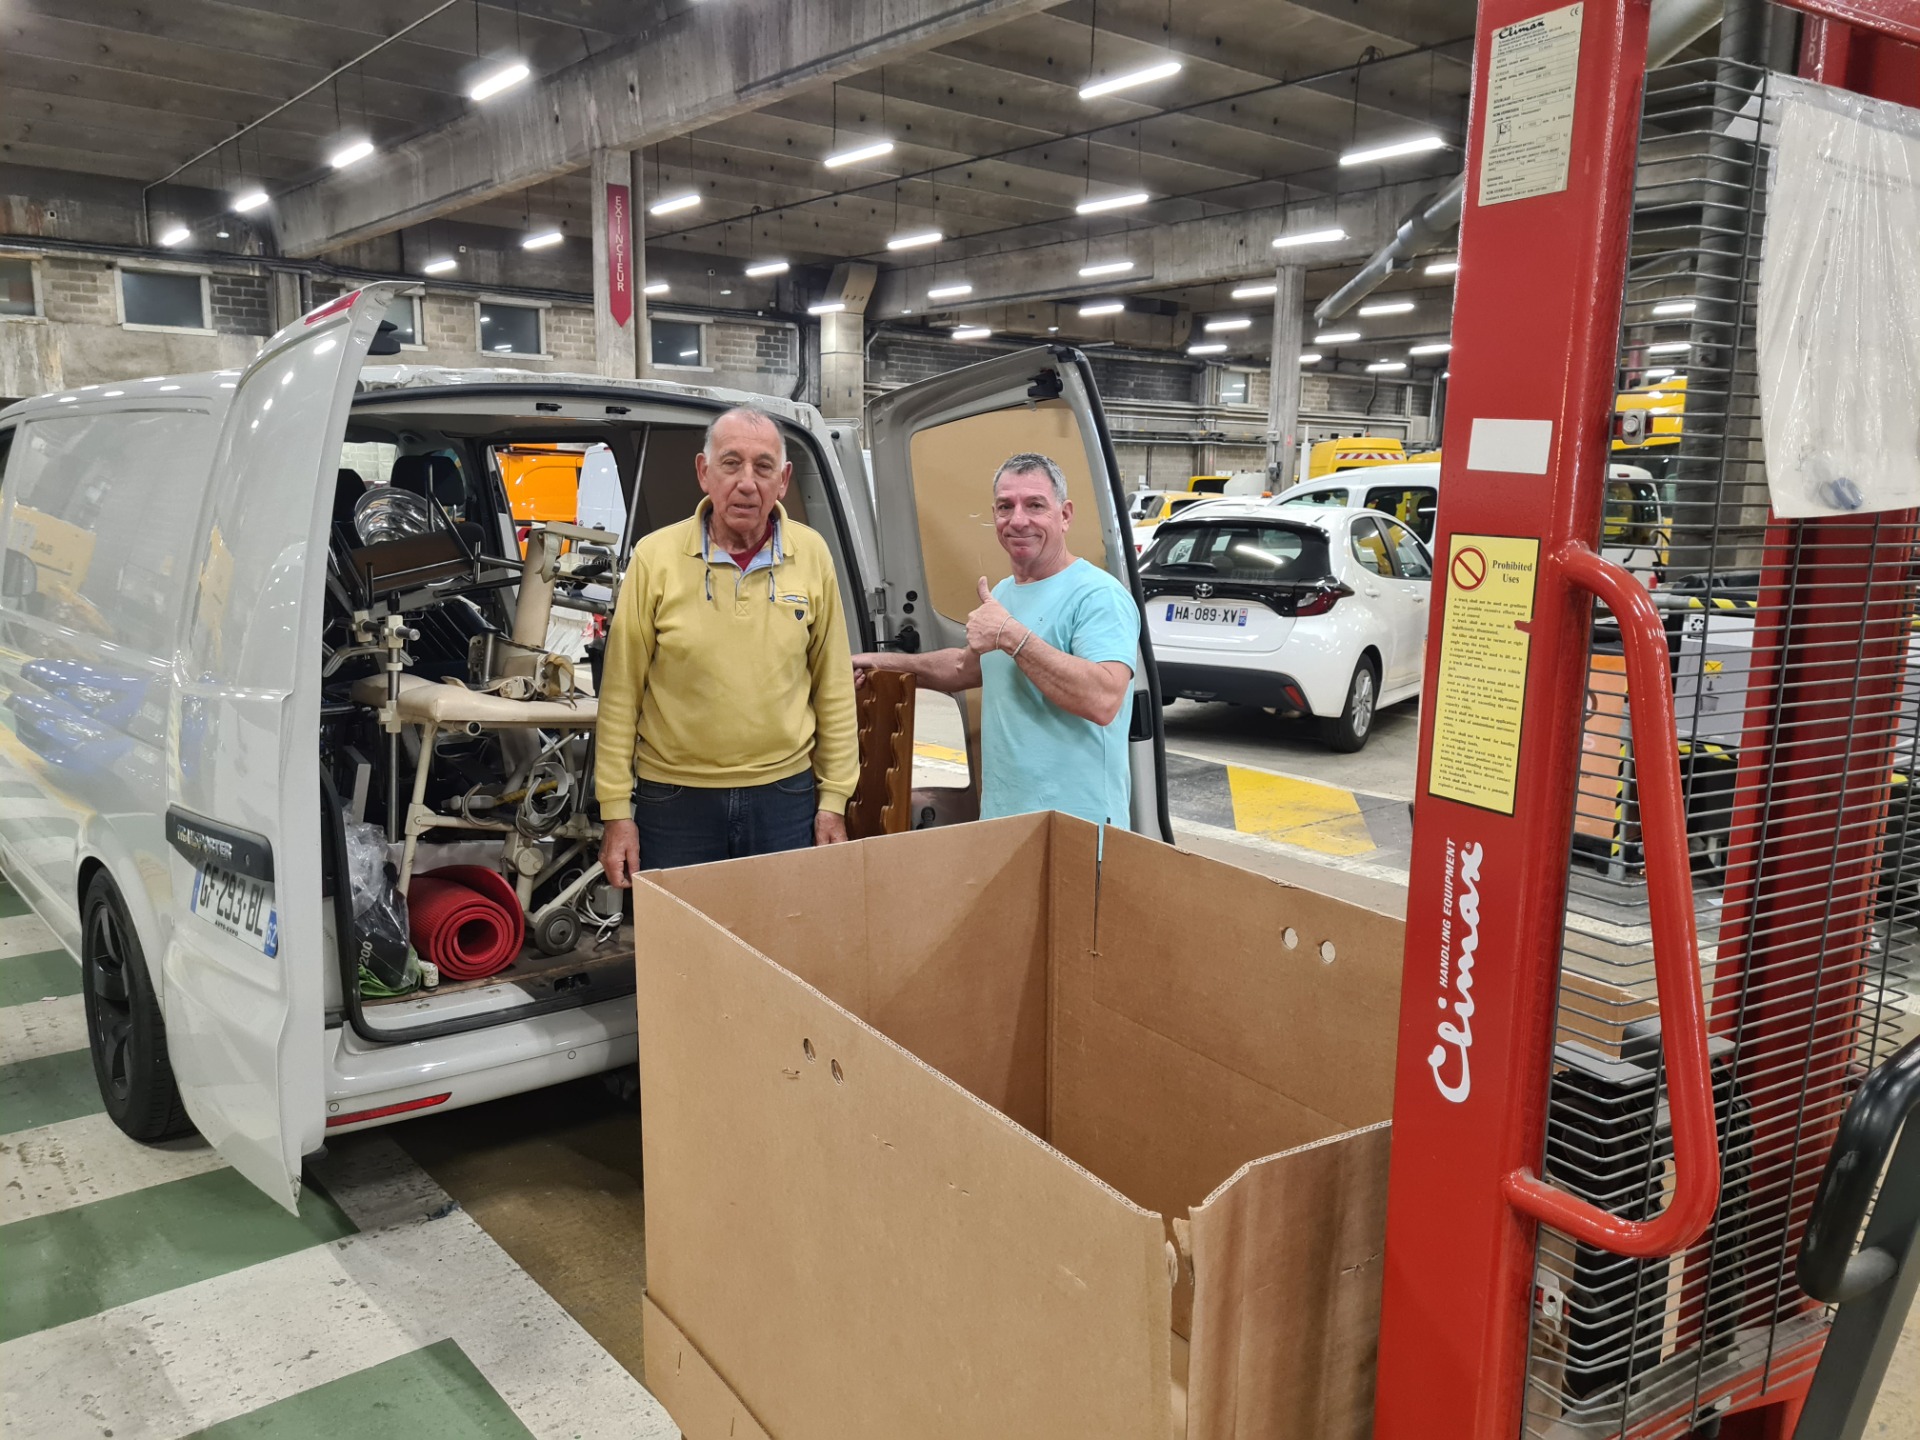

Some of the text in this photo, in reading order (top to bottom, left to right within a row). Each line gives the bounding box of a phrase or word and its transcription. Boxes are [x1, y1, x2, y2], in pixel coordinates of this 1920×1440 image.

[1498, 20, 1545, 39] Climax
[615, 195, 625, 292] EXTINCTEUR
[1492, 559, 1533, 572] Prohibited
[1502, 573, 1520, 584] Uses
[1175, 606, 1238, 623] HA-089-XV
[199, 862, 265, 937] GF-293-BL
[1439, 837, 1456, 988] HANDLING EQUIPMENT
[1427, 842, 1483, 1102] Climax
